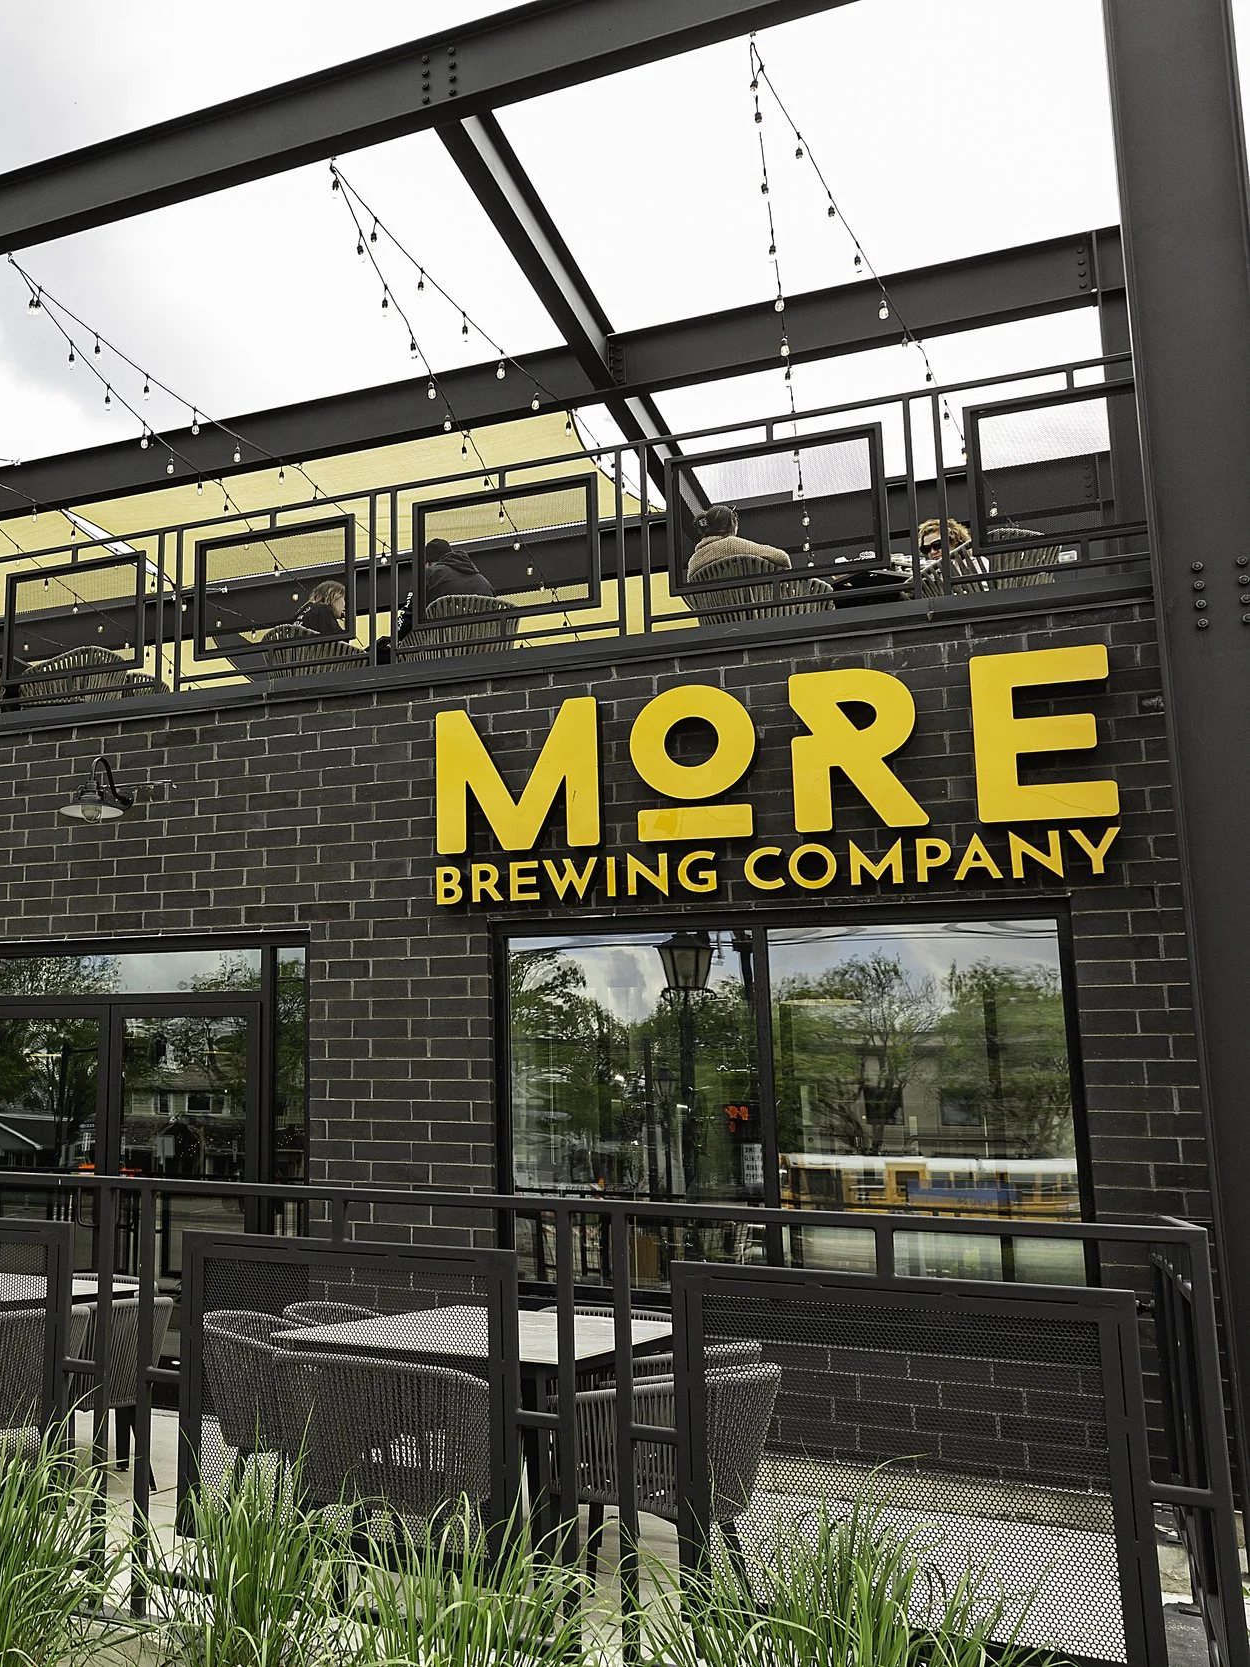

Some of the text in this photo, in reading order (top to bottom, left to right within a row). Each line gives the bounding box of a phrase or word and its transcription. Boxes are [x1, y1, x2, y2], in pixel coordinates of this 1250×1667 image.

[435, 644, 1120, 855] MORE
[435, 827, 1121, 905] BREWING COMPANY
